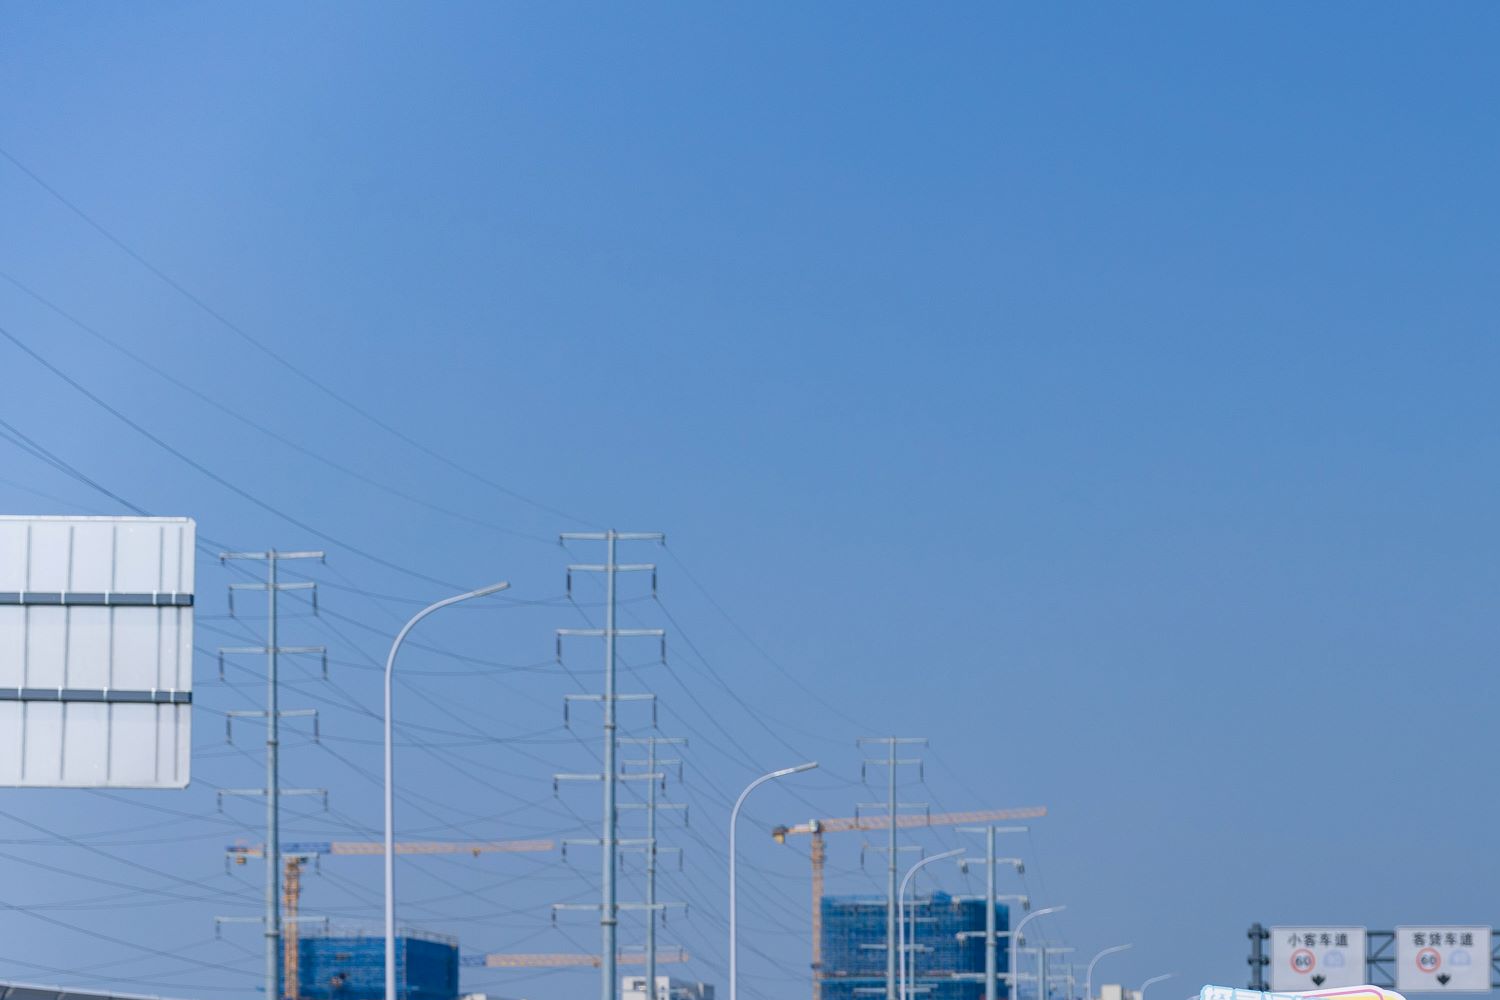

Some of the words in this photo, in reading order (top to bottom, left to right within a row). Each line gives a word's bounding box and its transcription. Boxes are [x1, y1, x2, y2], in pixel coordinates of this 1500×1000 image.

[1288, 932, 1348, 946] 小客车道
[1295, 954, 1312, 967] 60
[1420, 954, 1437, 966] 60
